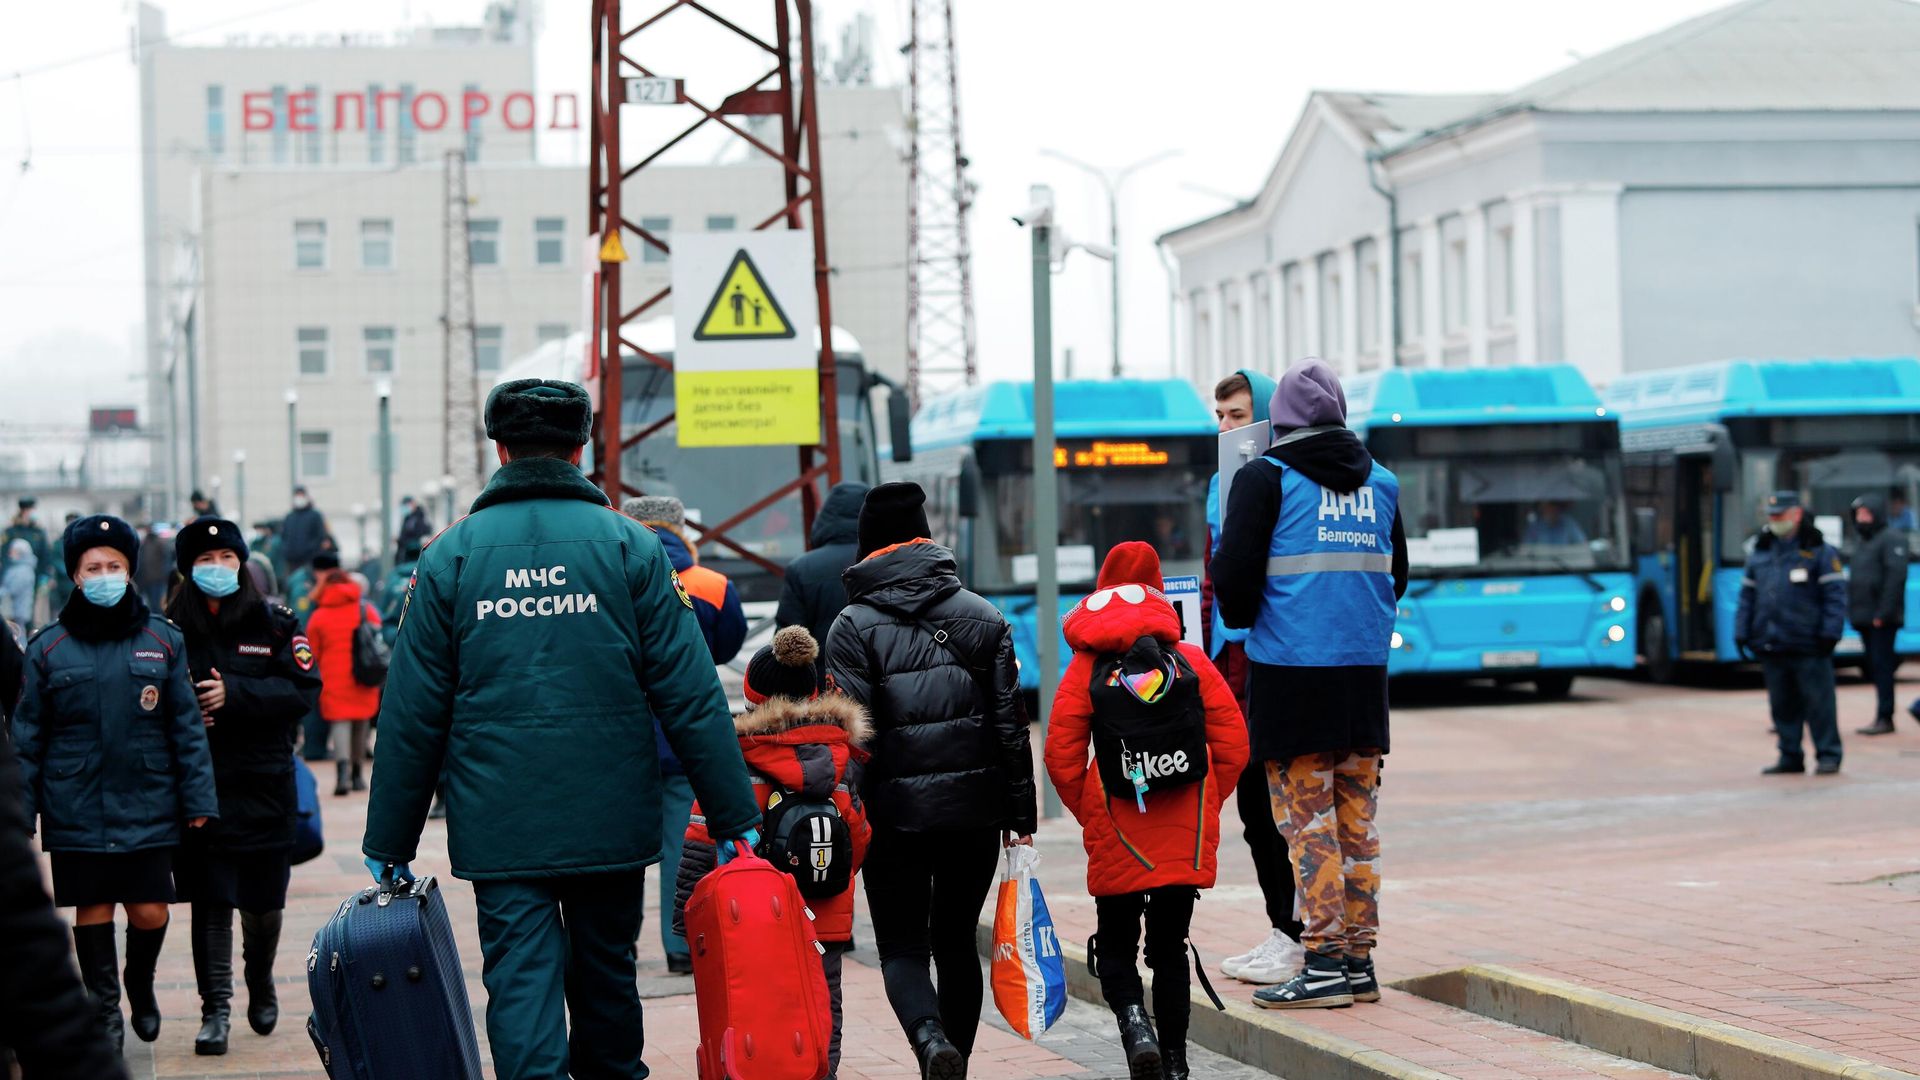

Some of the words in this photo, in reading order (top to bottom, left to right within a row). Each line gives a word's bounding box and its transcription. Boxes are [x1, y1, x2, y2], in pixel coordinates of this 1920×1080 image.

[635, 81, 668, 101] 127
[243, 92, 580, 132] БЕЛГОРОД
[1318, 486, 1376, 523] ДНД
[1318, 526, 1376, 548] Белгород
[505, 565, 567, 588] МЧС
[476, 593, 598, 620] РОССИИ
[136, 651, 164, 659] ПОЛИЦИЯ
[240, 645, 271, 654] ПОЛИЦИЯ
[1121, 750, 1189, 780] Likee
[817, 849, 826, 867] 1
